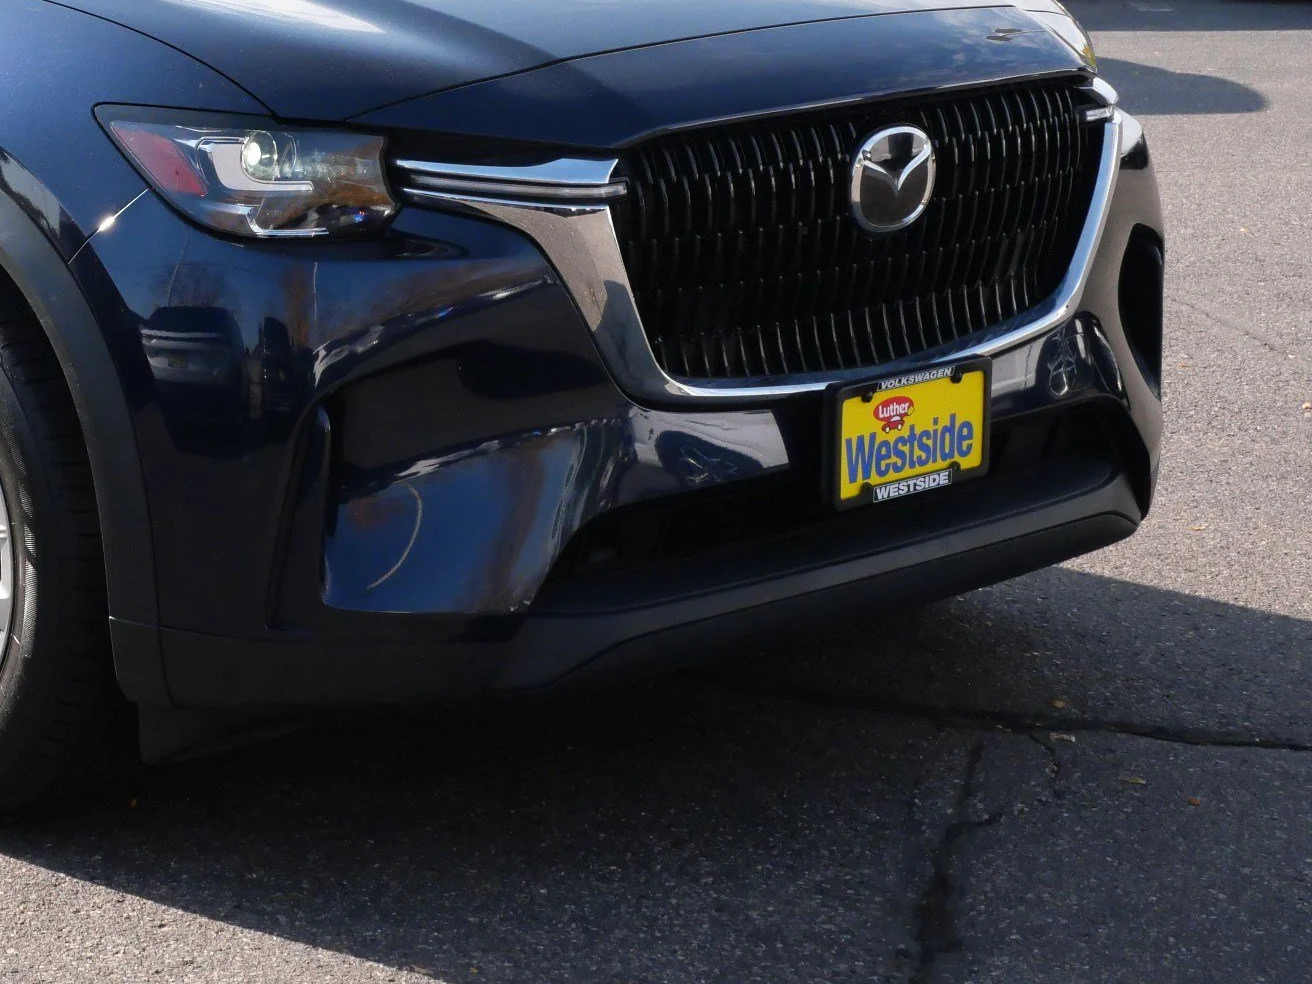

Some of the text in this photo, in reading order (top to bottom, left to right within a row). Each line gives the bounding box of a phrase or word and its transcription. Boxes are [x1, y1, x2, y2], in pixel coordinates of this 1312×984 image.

[881, 367, 953, 390] VOLKSWAGEN
[878, 401, 911, 419] Luther
[845, 413, 974, 485] Westside
[876, 470, 950, 500] WESTSIDE
